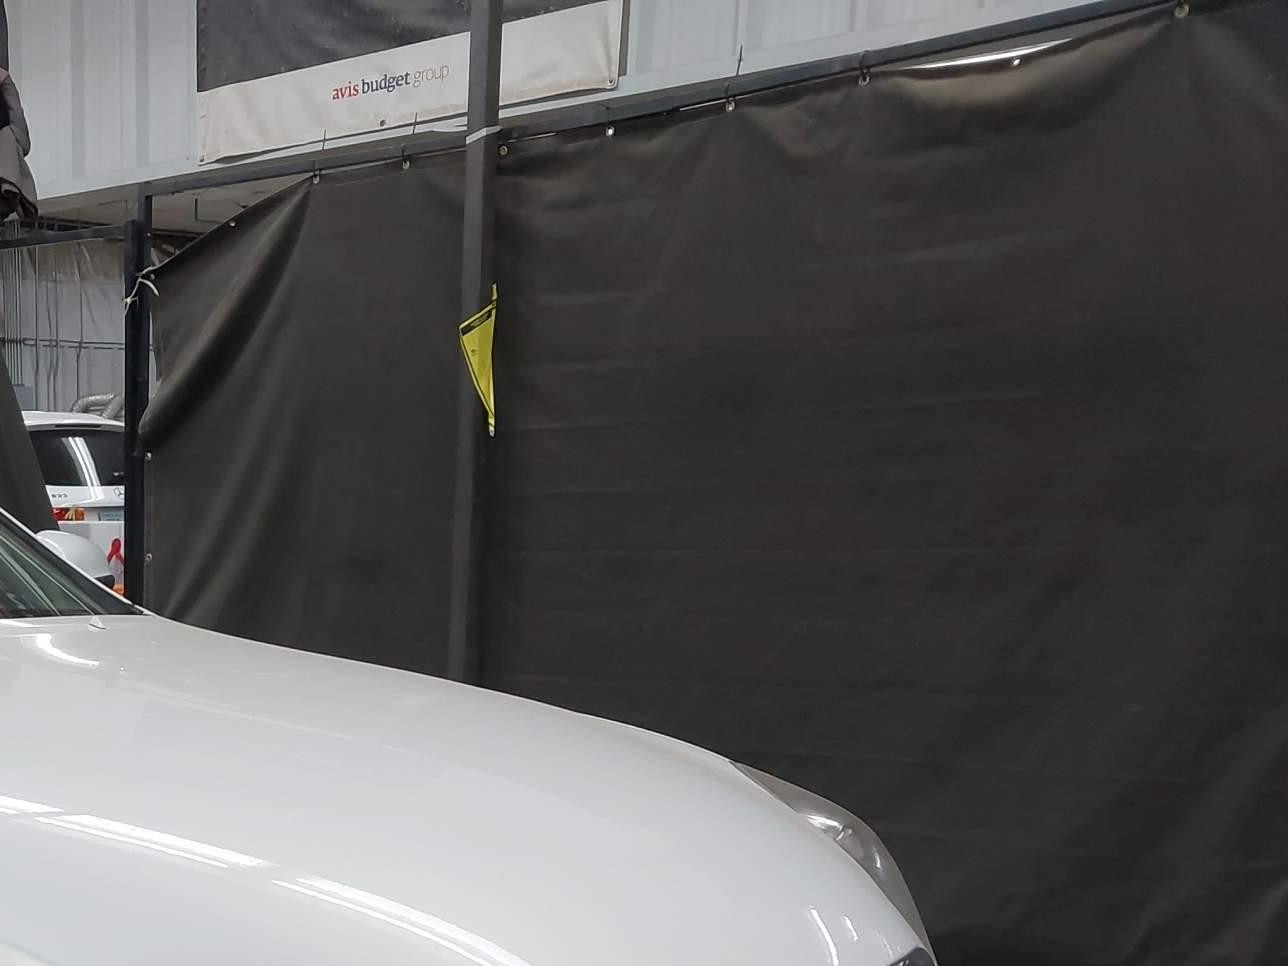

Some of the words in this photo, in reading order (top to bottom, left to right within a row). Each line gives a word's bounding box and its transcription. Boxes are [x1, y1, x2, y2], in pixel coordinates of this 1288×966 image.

[332, 81, 360, 100] avis
[361, 71, 411, 93] budget
[412, 64, 450, 88] group
